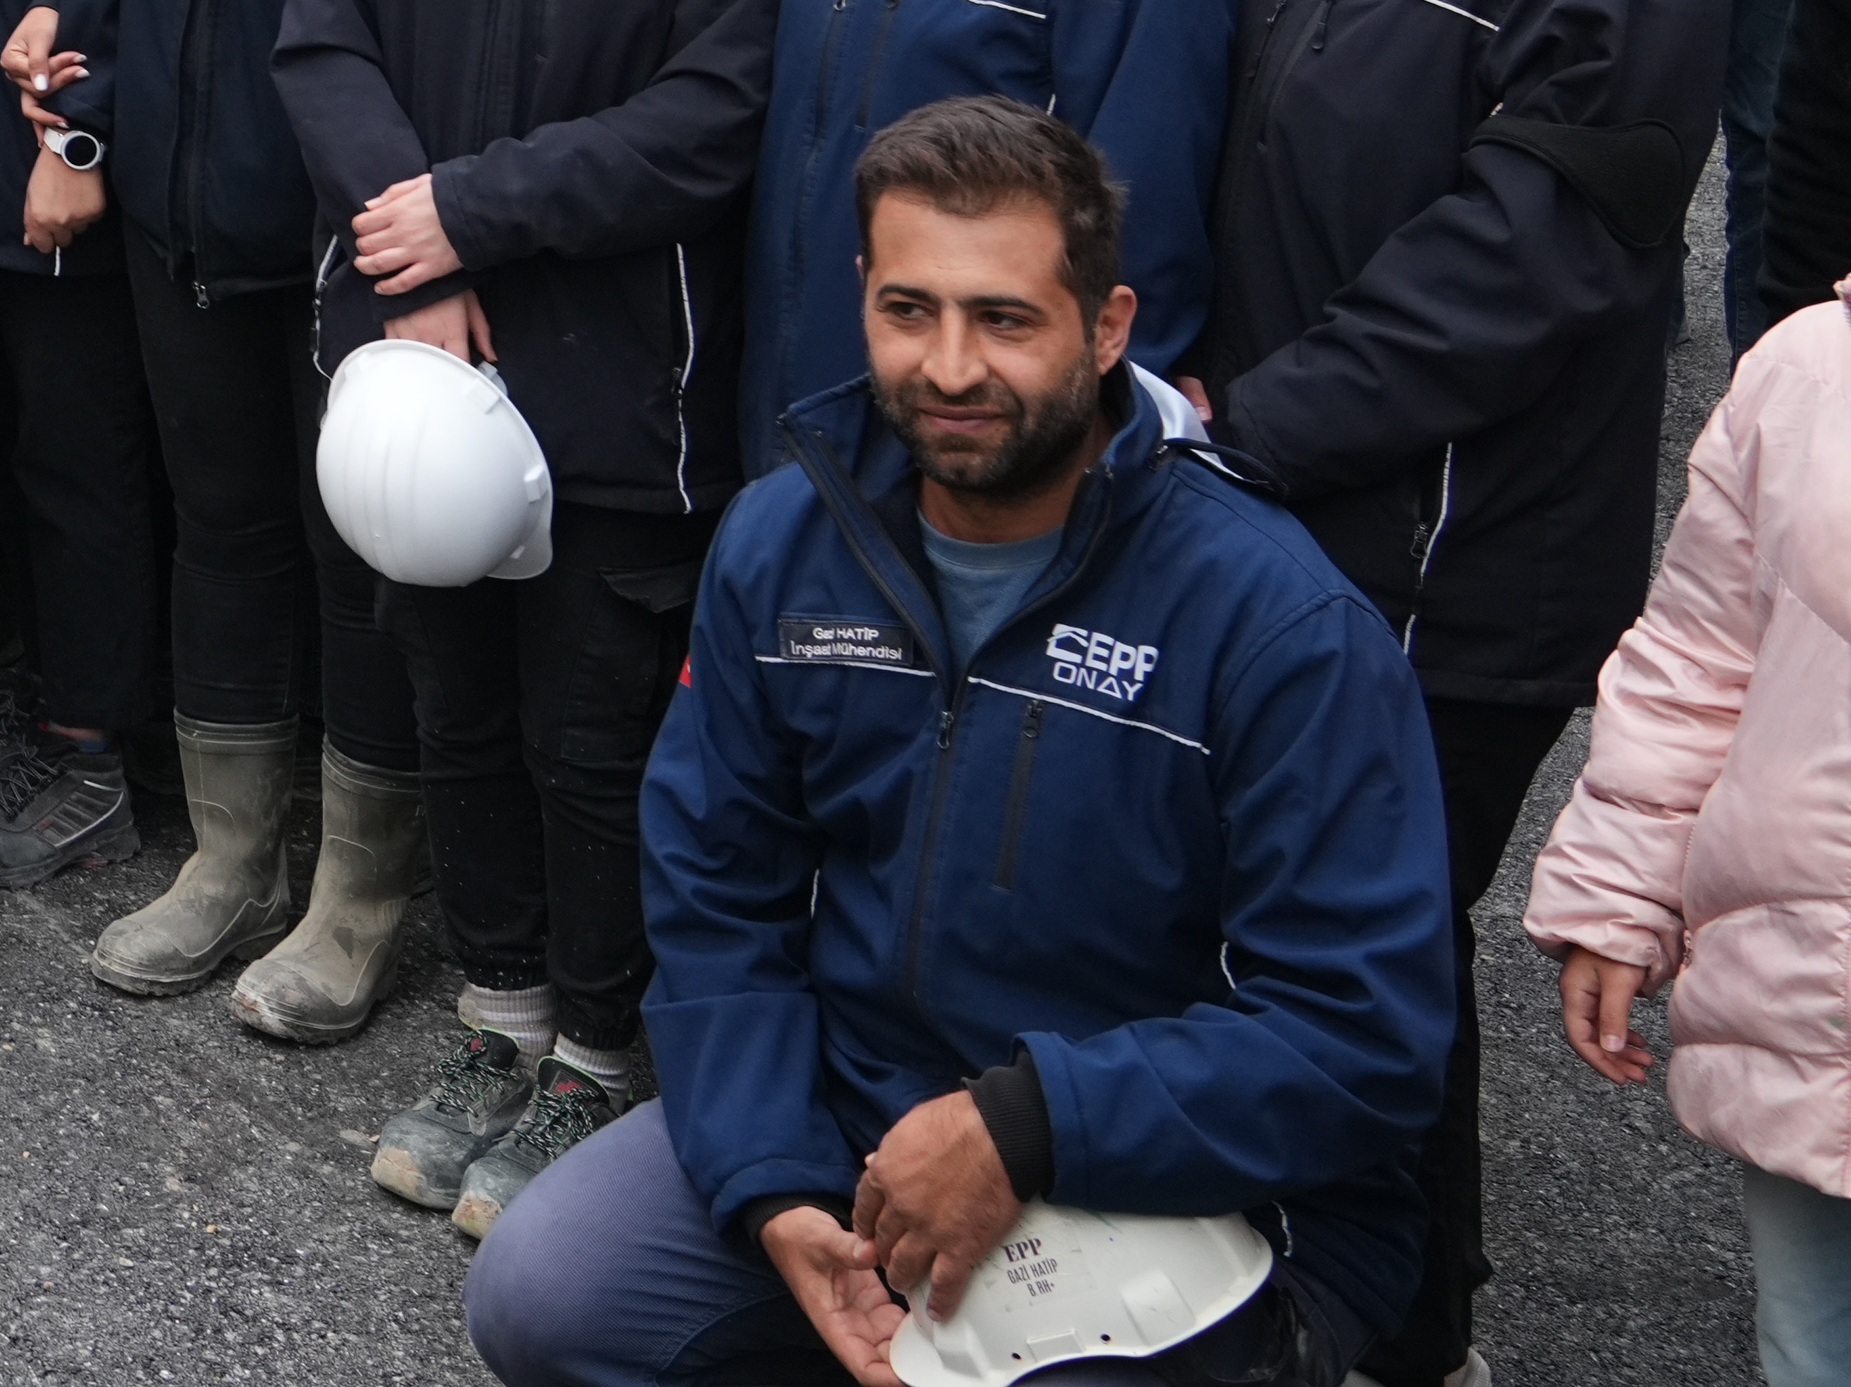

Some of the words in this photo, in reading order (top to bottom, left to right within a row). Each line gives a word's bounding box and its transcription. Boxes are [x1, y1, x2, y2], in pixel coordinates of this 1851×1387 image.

[836, 626, 880, 641] HATİP
[832, 641, 902, 660] Mühendisi
[1085, 632, 1160, 674] EPP
[1052, 661, 1145, 703] ONAY
[1004, 1238, 1042, 1262] EPP
[1031, 1258, 1058, 1278] HATİP
[1026, 1282, 1036, 1297] B
